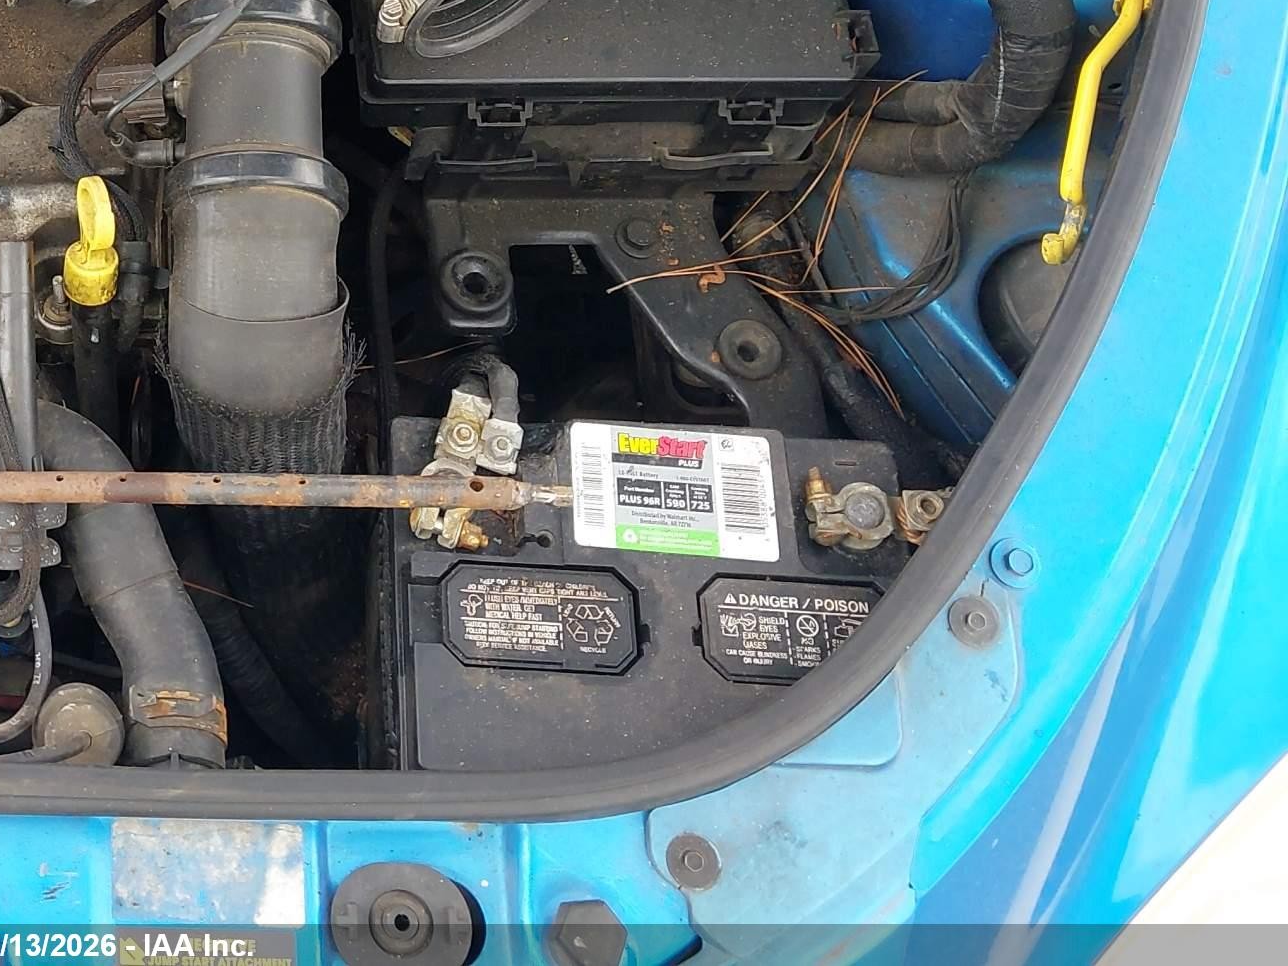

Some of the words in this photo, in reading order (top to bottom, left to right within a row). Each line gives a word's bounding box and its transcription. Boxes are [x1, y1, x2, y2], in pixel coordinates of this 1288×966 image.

[617, 432, 708, 459] EverStart
[678, 459, 700, 468] PLUS
[619, 494, 642, 504] PLUS
[666, 499, 686, 509] 590
[691, 500, 711, 511] 725
[739, 594, 799, 609] DANGER
[814, 598, 869, 614] POISON
[758, 617, 785, 625] SHIELD
